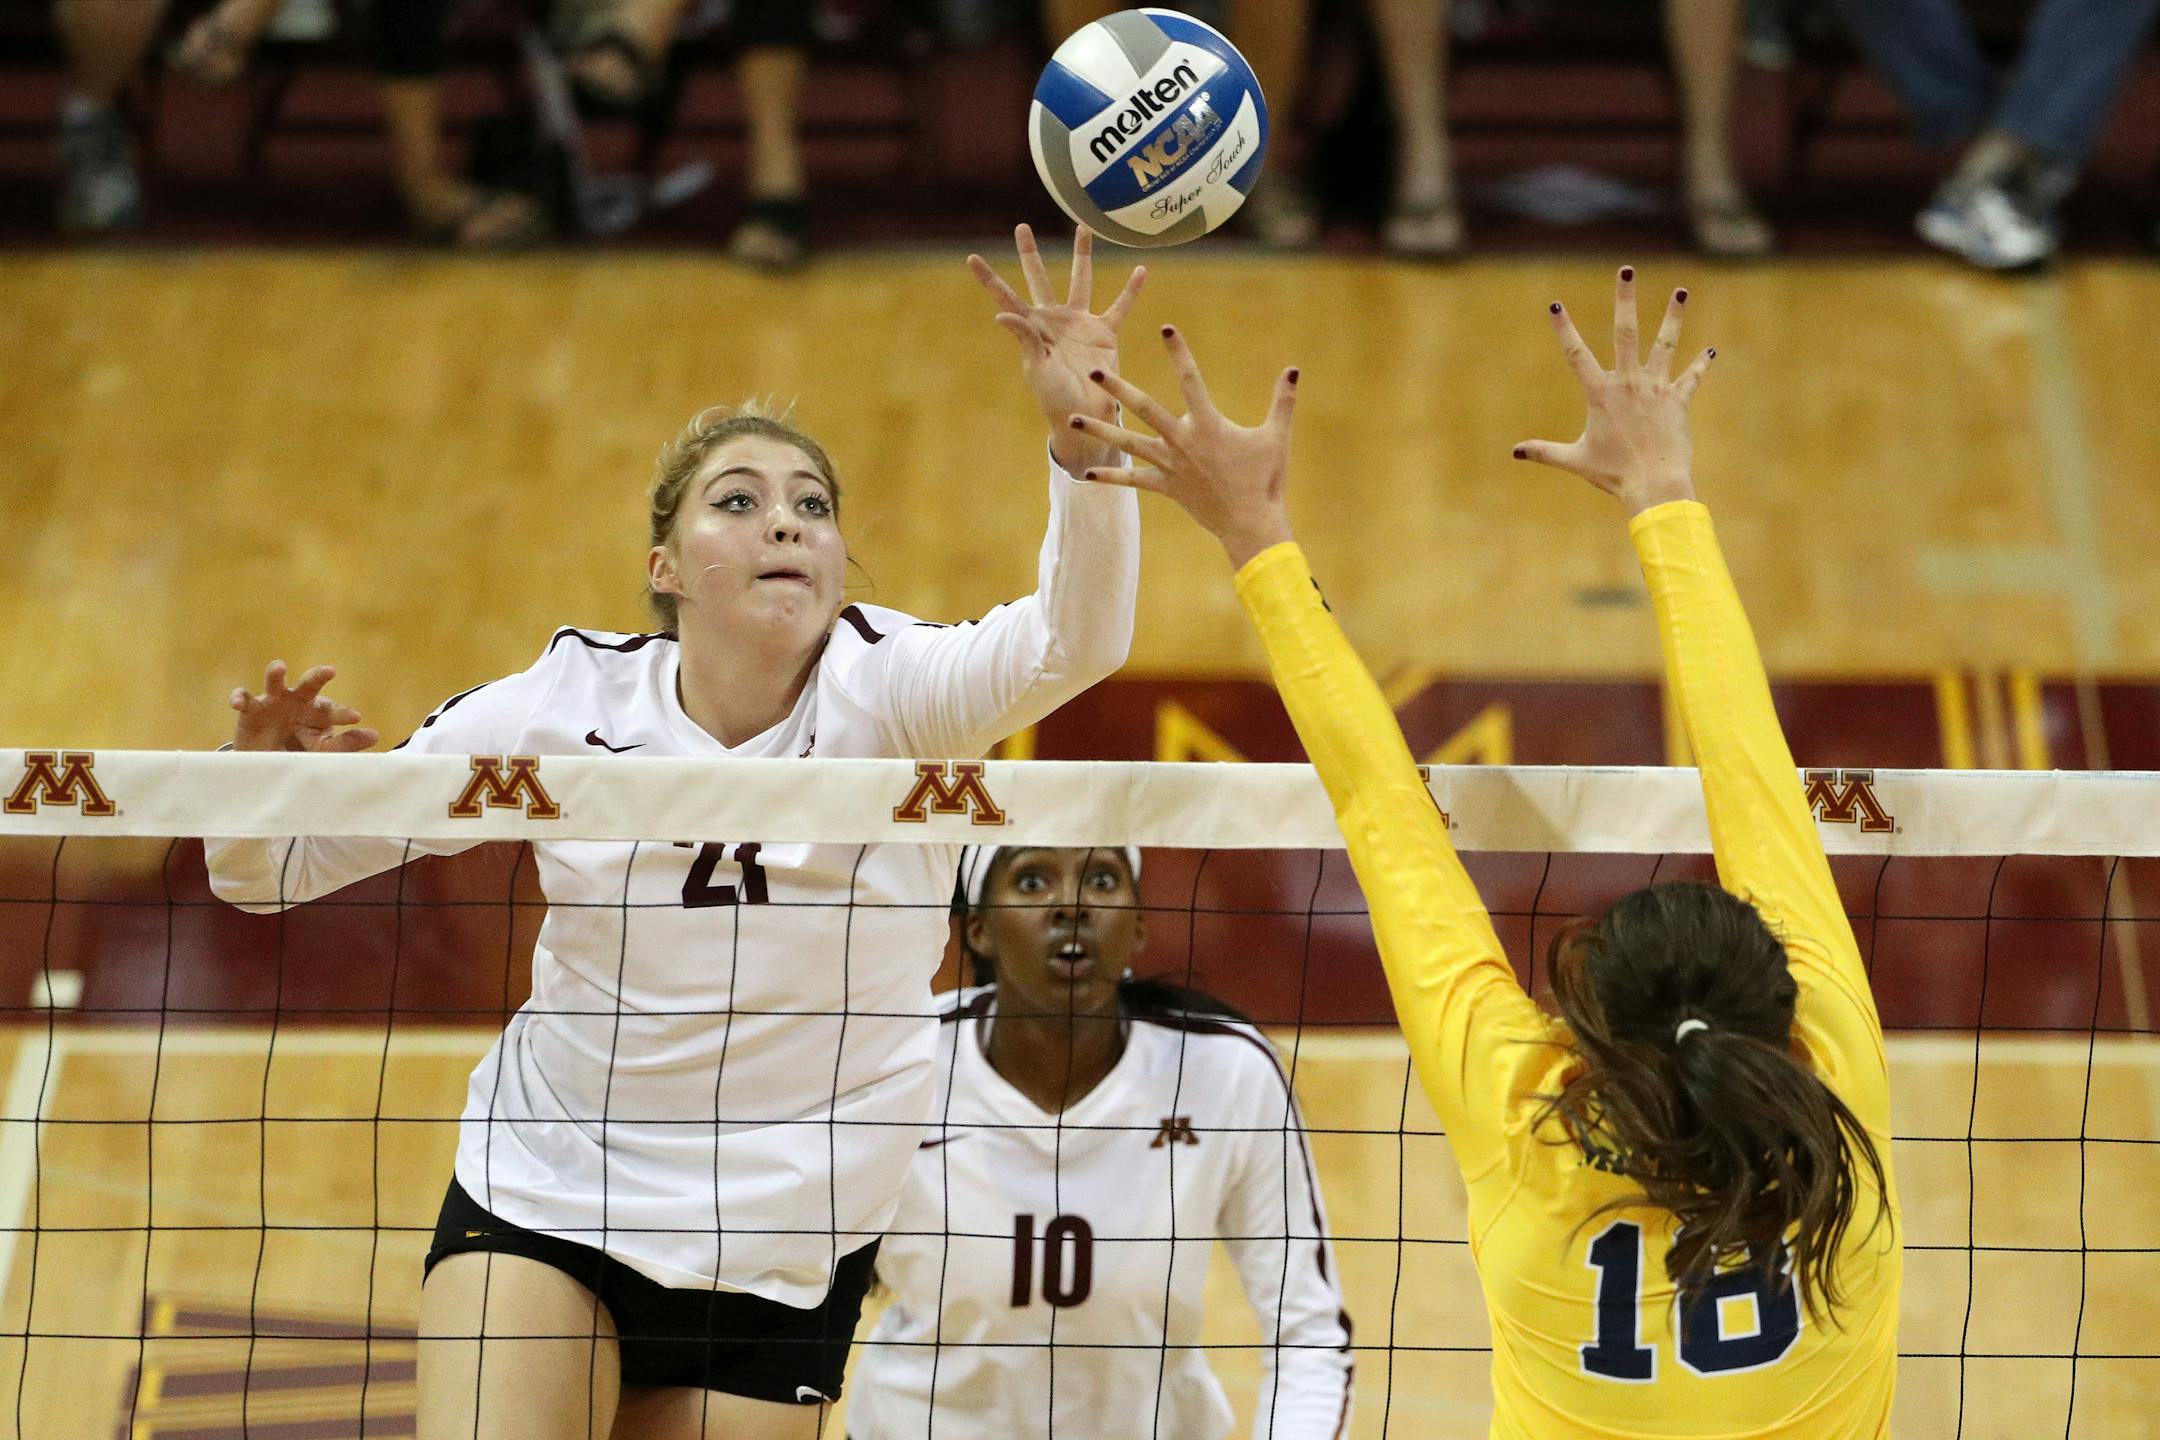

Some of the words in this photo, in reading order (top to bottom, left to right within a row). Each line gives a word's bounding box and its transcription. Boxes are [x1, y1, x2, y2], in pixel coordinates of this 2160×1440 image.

[1090, 64, 1199, 163] molten
[1126, 97, 1221, 190] NCAA
[1150, 186, 1202, 219] Super
[1206, 130, 1245, 184] Touch
[4, 751, 115, 816] M
[448, 755, 560, 819] M
[893, 761, 1005, 825] M
[1011, 1214, 1093, 1308] 10
